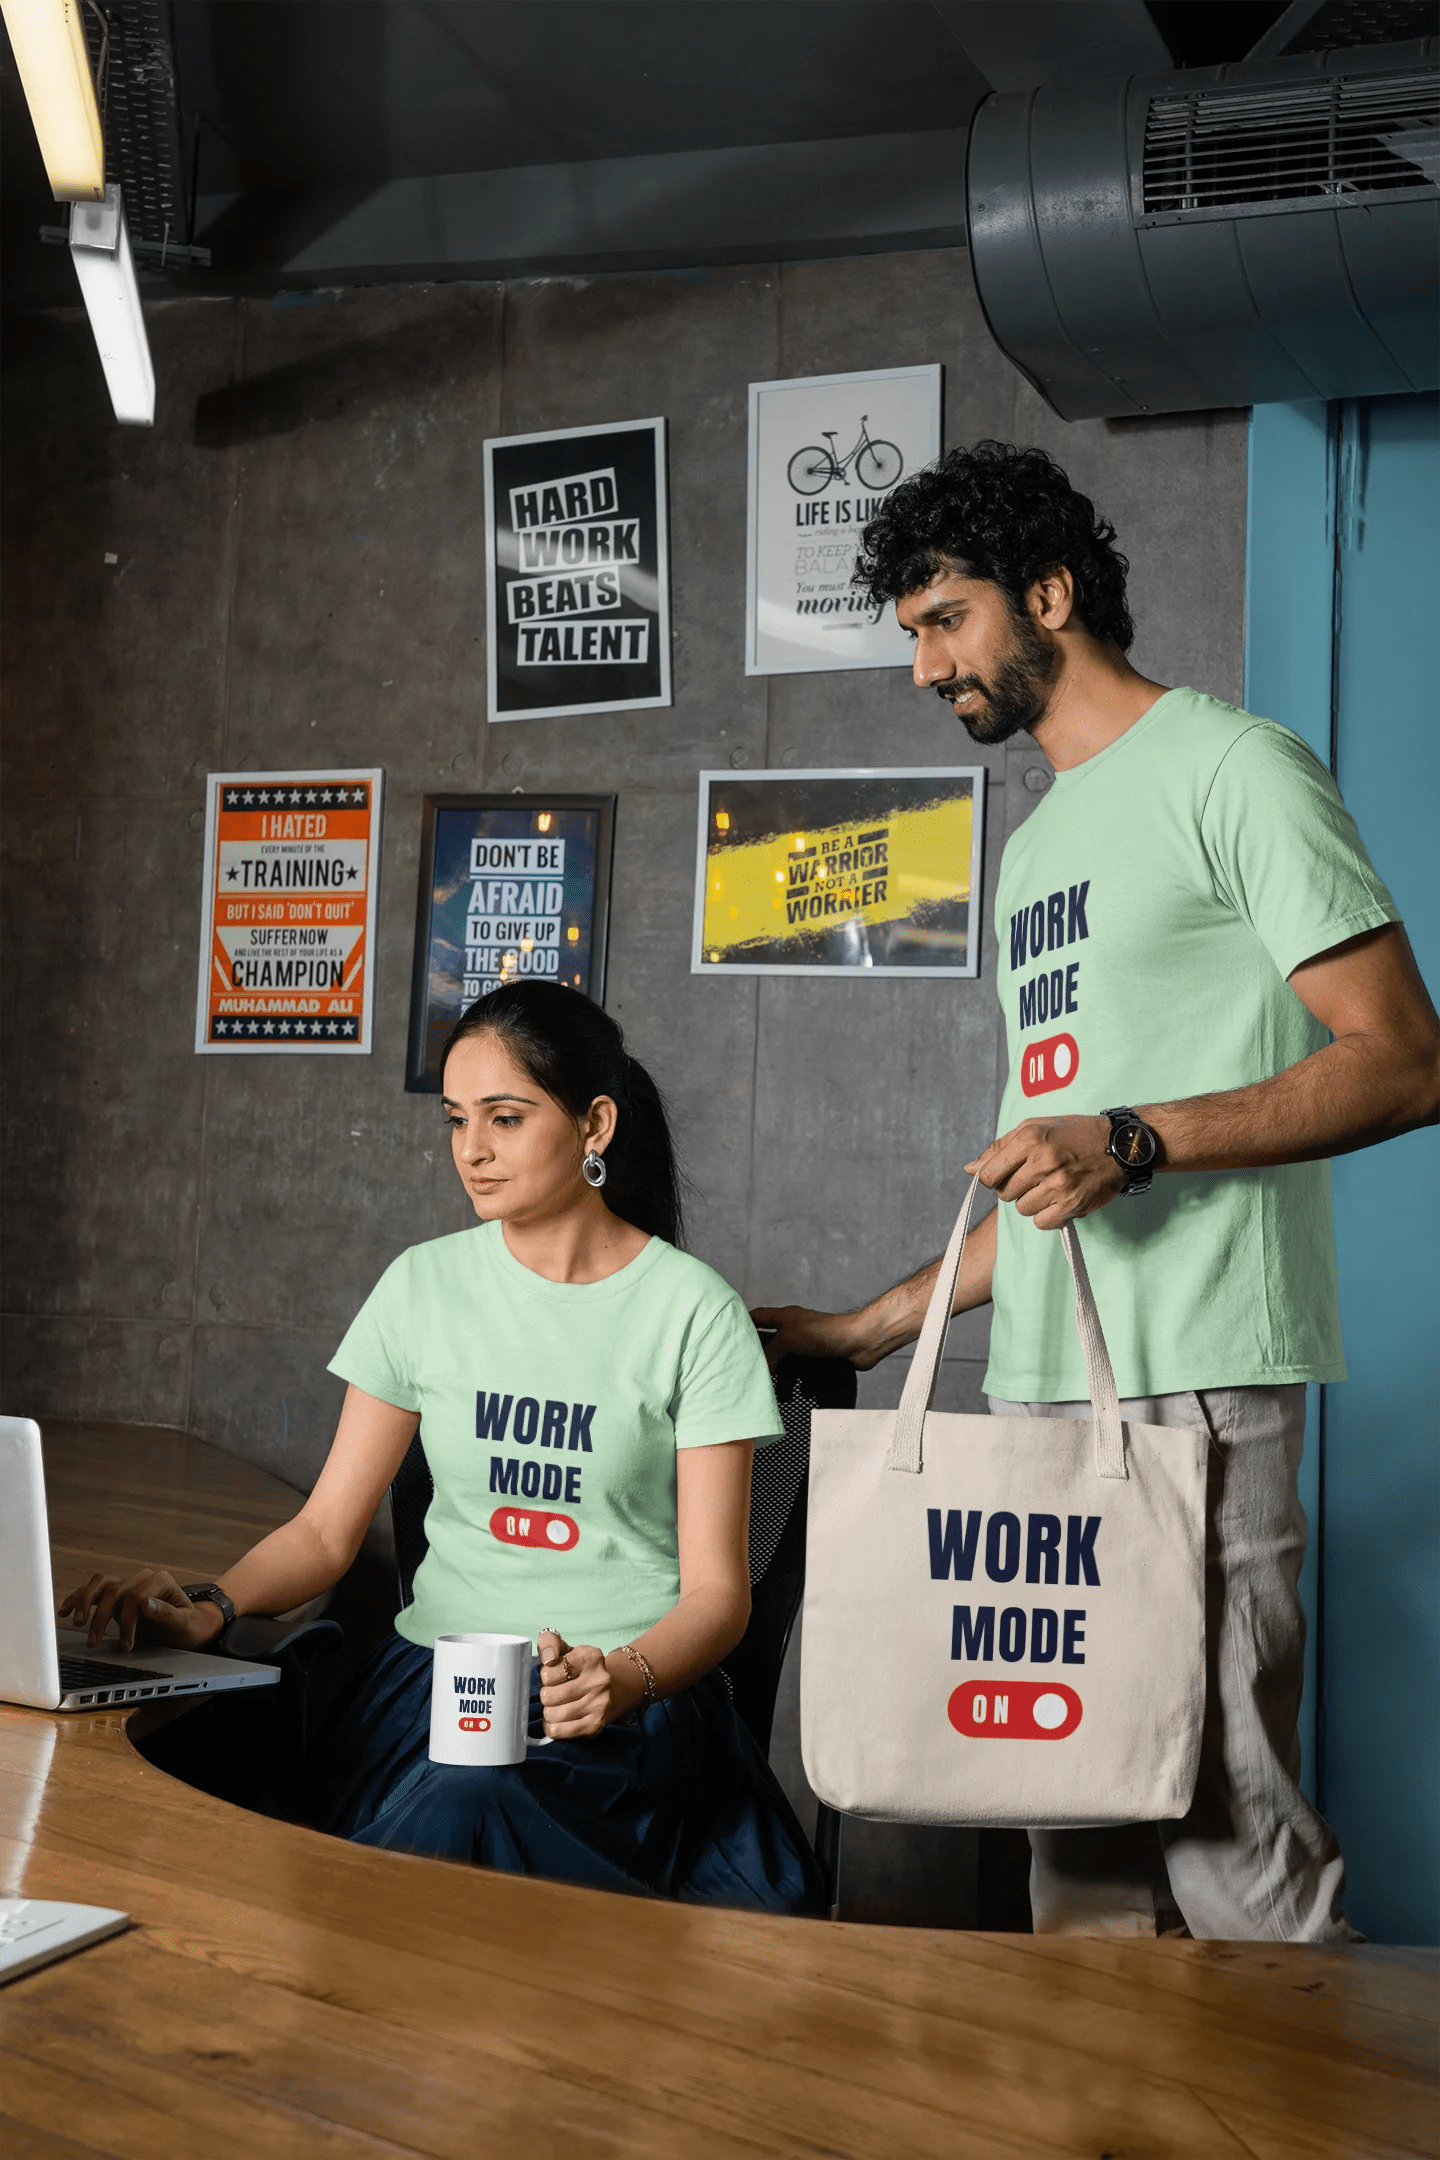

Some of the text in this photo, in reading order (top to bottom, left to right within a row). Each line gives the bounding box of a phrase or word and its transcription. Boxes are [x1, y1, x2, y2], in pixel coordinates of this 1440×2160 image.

[514, 476, 615, 529] HARD
[796, 497, 882, 526] LIFE IS LIK
[522, 523, 638, 568] WORK
[796, 546, 815, 559] TO
[817, 543, 851, 558] KEEP
[795, 557, 851, 576] BALA
[513, 571, 618, 619] BEATS
[797, 582, 815, 593] You
[818, 582, 845, 592] must
[797, 591, 885, 625] moving
[520, 625, 646, 662] TALENT
[261, 814, 327, 839] I HATED
[475, 844, 560, 868] DON'T BE
[821, 835, 853, 854] BE A
[241, 859, 344, 887] TRAINING
[789, 842, 888, 885] WARRIOR
[814, 873, 857, 893] NOT A
[226, 903, 249, 920] BUT
[251, 903, 255, 920] I
[257, 903, 284, 920] SAID
[467, 881, 564, 915] AFRAID
[251, 928, 328, 945] SUFFER NOW
[472, 921, 555, 940] TO GIVE UP
[1010, 880, 1090, 971] WORK
[464, 947, 500, 972] THE
[231, 960, 344, 988] CHAMPION
[463, 979, 480, 997] TO
[218, 998, 353, 1013] MUHAMMAD ALI
[1019, 962, 1080, 1031] MODE
[1029, 1053, 1044, 1084] ON
[476, 1390, 597, 1452] WORK
[489, 1456, 582, 1504] MODE
[506, 1516, 530, 1536] ON
[927, 1508, 1102, 1587] WORK
[951, 1605, 1086, 1664] MODE
[454, 1676, 496, 1695] WORK
[459, 1699, 492, 1714] MODE
[972, 1694, 1009, 1724] ON
[464, 1720, 474, 1728] ON
